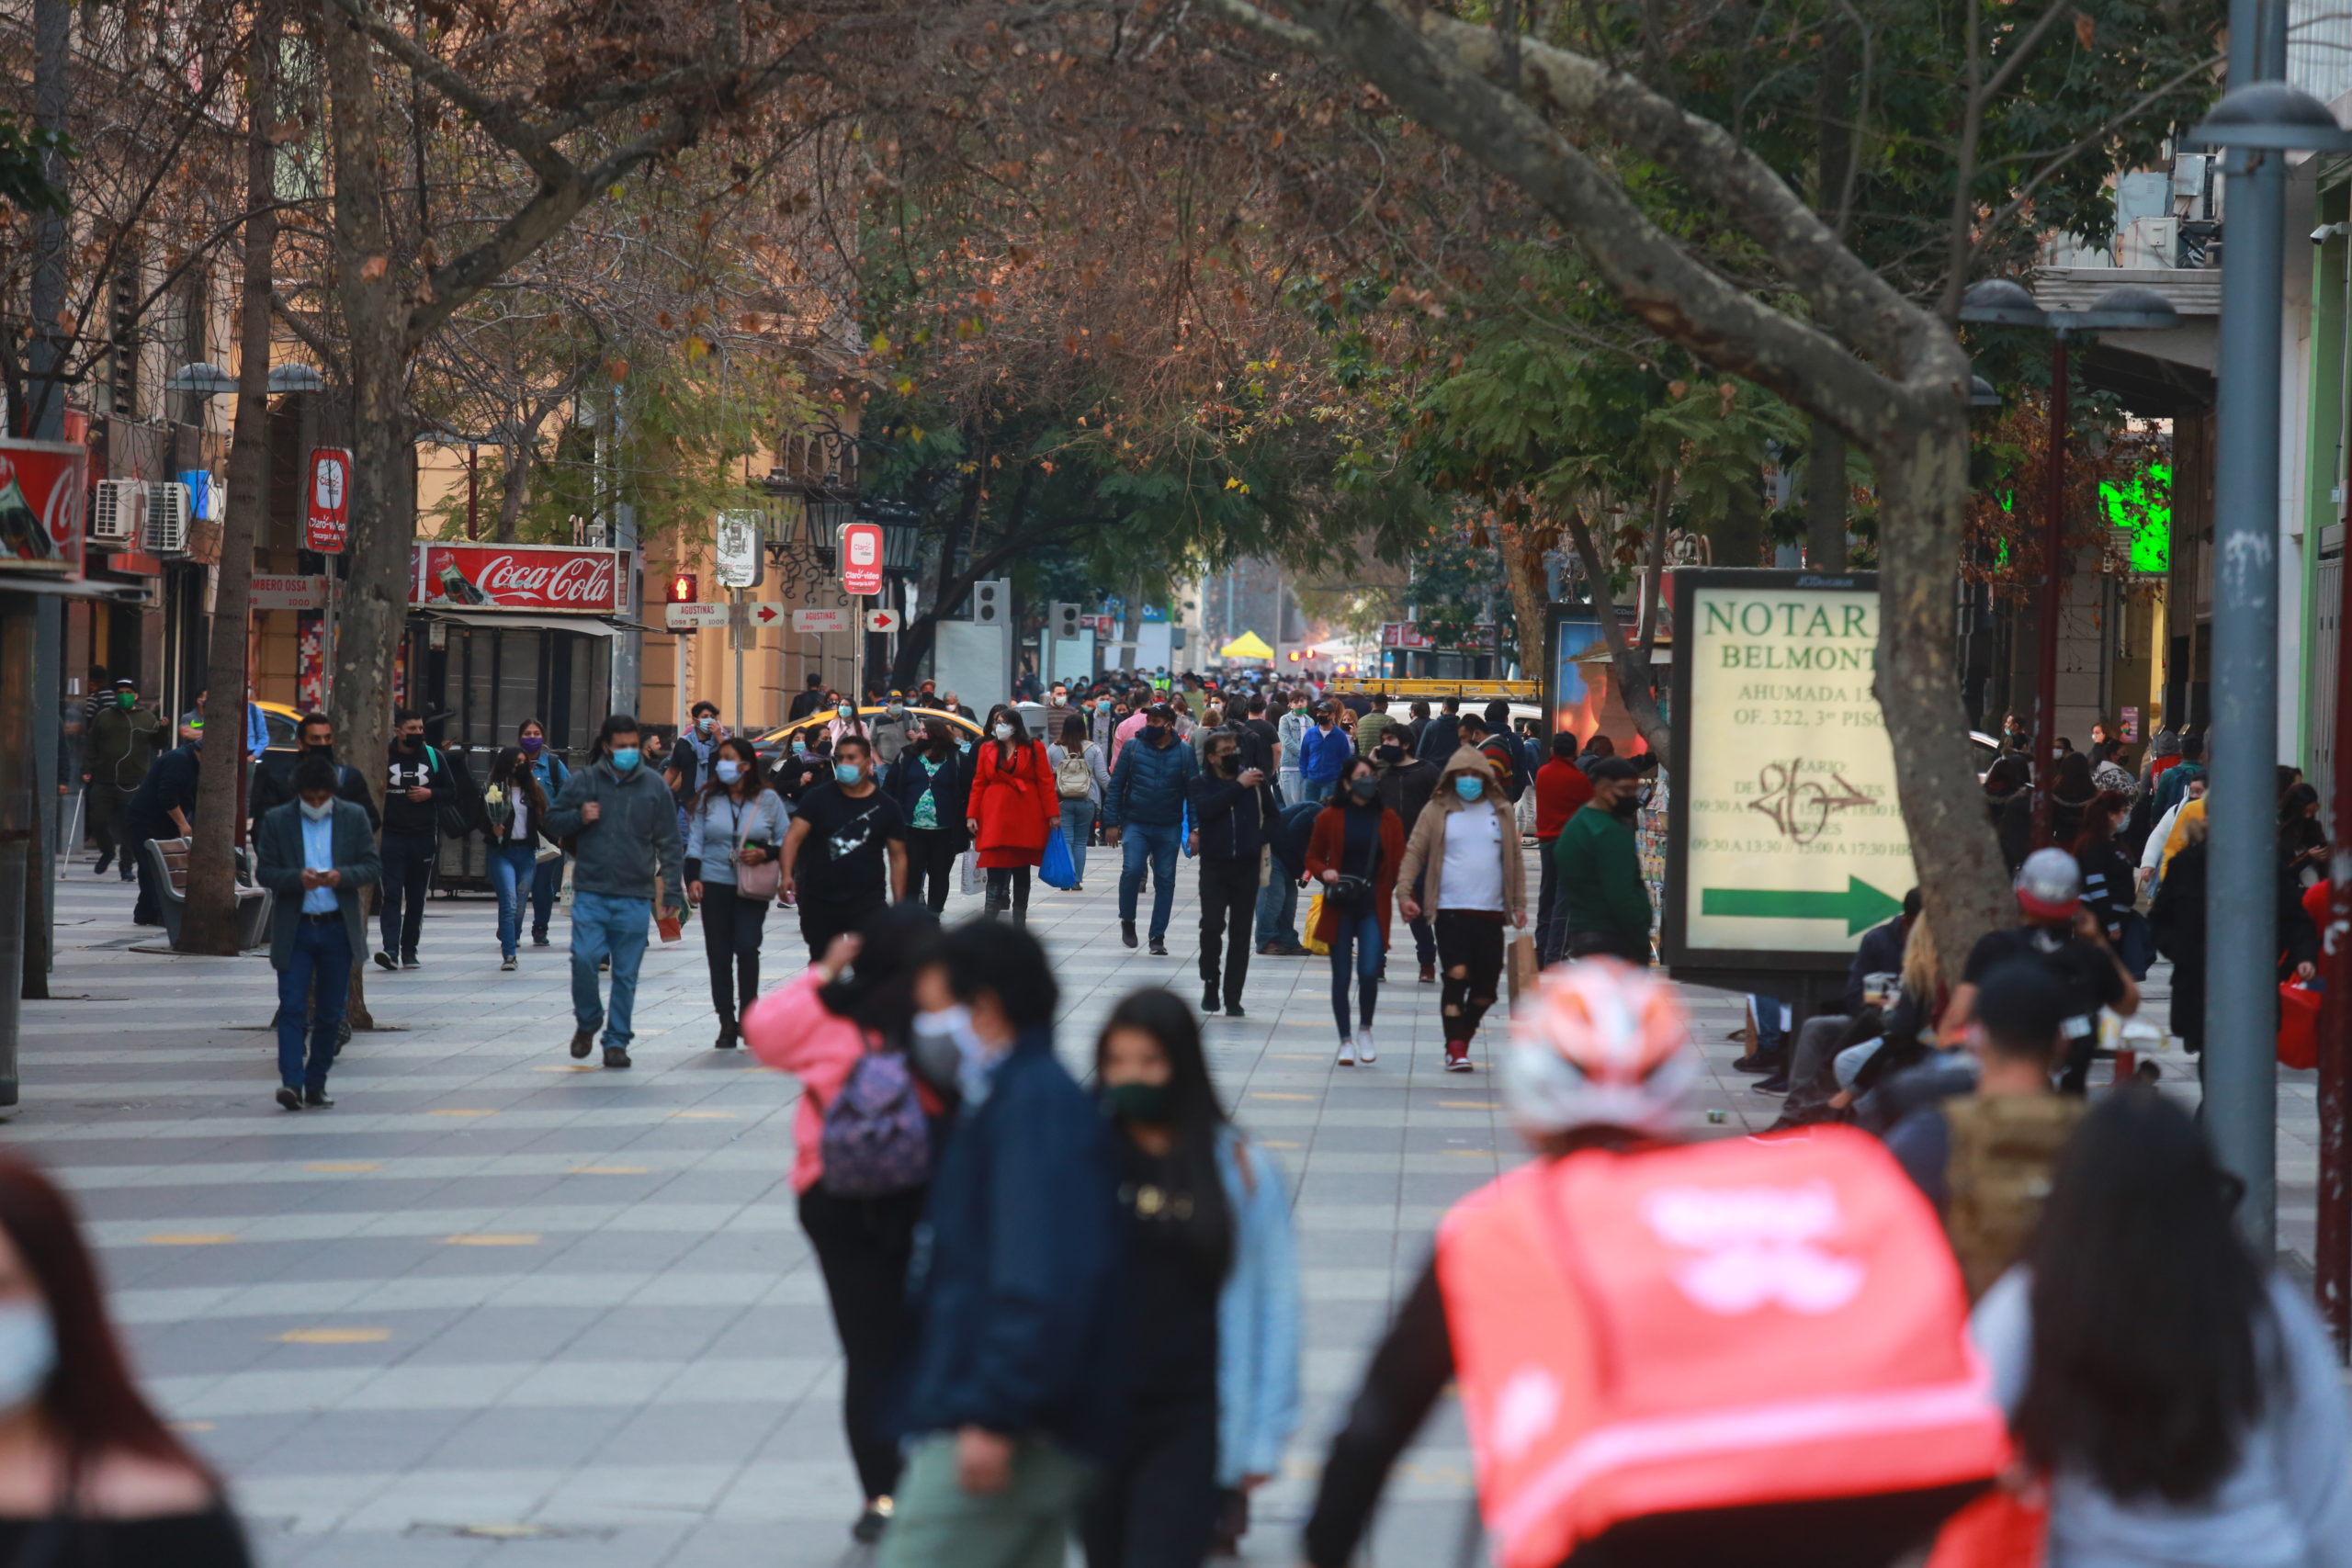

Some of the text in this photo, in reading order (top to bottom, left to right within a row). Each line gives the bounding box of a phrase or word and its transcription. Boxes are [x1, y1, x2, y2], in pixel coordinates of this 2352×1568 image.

[250, 579, 307, 592] MBERO OSSA
[288, 598, 310, 606] 1000
[680, 605, 715, 615] AGUSTINAS
[1703, 601, 1880, 638] NOTAR
[1736, 683, 1847, 702] AHUMADA
[1734, 708, 1765, 726] OF.
[1734, 781, 1757, 795] DE
[1731, 838, 1743, 852] A
[1836, 842, 1848, 855] A
[1850, 843, 1886, 857] 17:30
